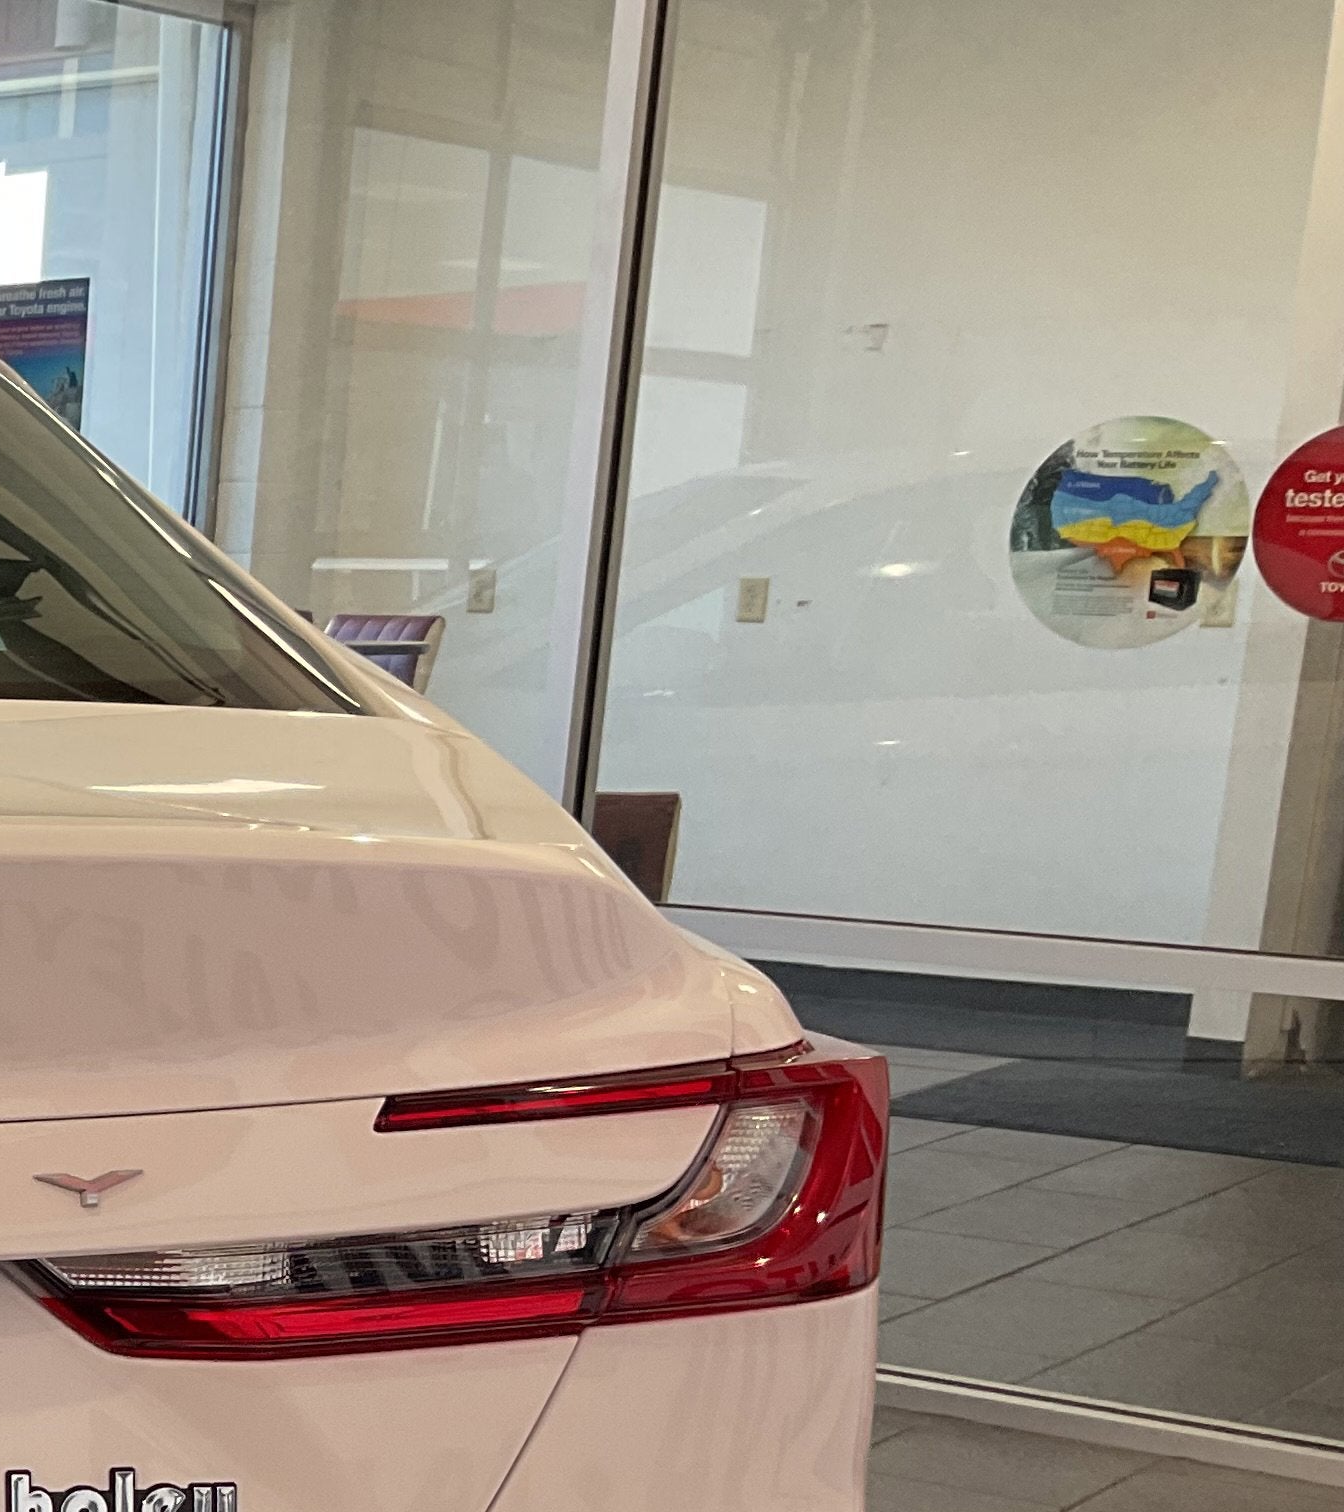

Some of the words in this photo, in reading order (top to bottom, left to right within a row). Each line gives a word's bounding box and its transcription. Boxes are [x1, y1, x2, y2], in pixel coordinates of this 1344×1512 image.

[38, 285, 67, 299] fresh
[68, 285, 86, 298] air.
[10, 302, 45, 318] Toyota
[47, 299, 87, 315] engine.
[1076, 449, 1099, 458] How
[1102, 449, 1162, 458] Temperature
[1165, 450, 1200, 458] Affects
[1097, 460, 1118, 469] Your
[1120, 460, 1158, 469] Battery
[1159, 460, 1177, 469] Life
[1303, 470, 1332, 483] Get
